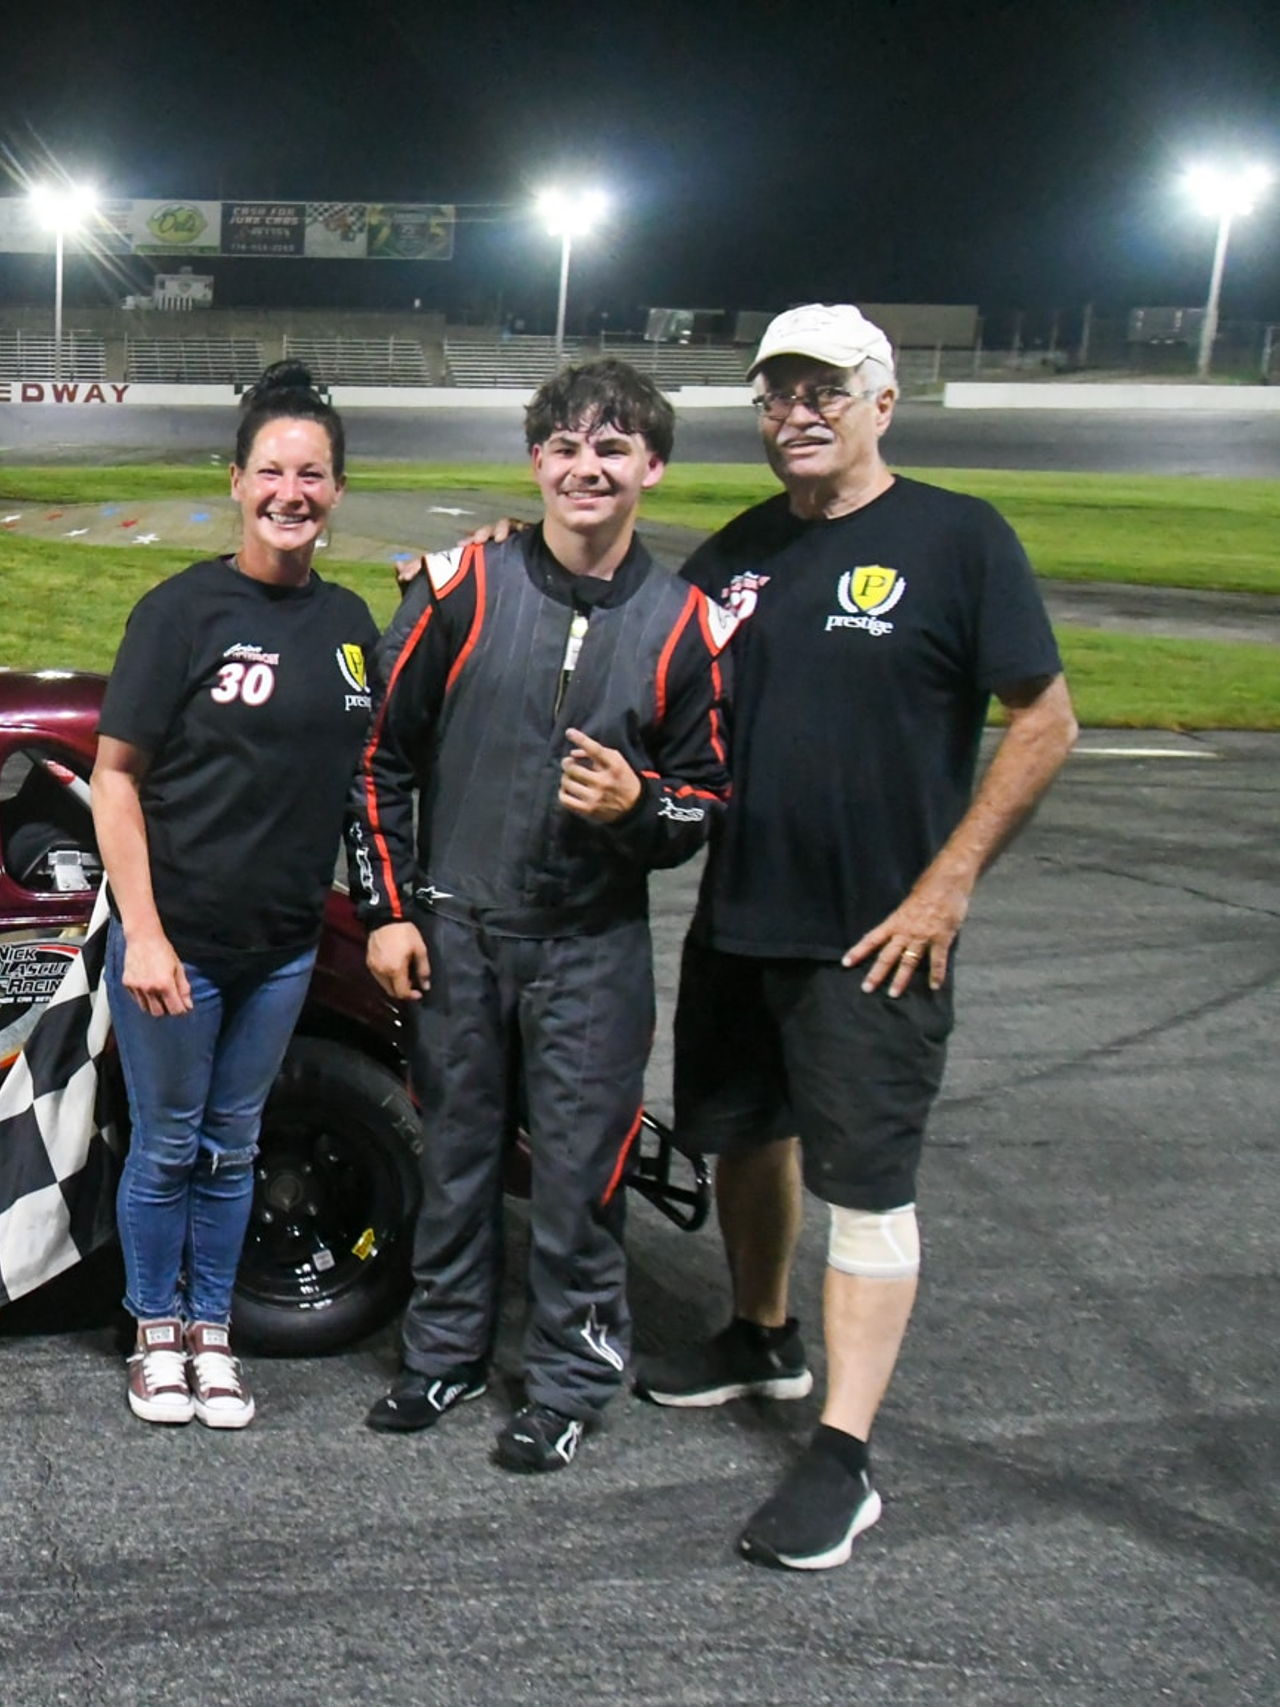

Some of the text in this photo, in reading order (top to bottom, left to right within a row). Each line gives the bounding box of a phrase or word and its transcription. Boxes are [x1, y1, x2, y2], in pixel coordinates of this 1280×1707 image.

[859, 574, 886, 597] P
[824, 614, 894, 637] prestige
[211, 662, 275, 706] 30
